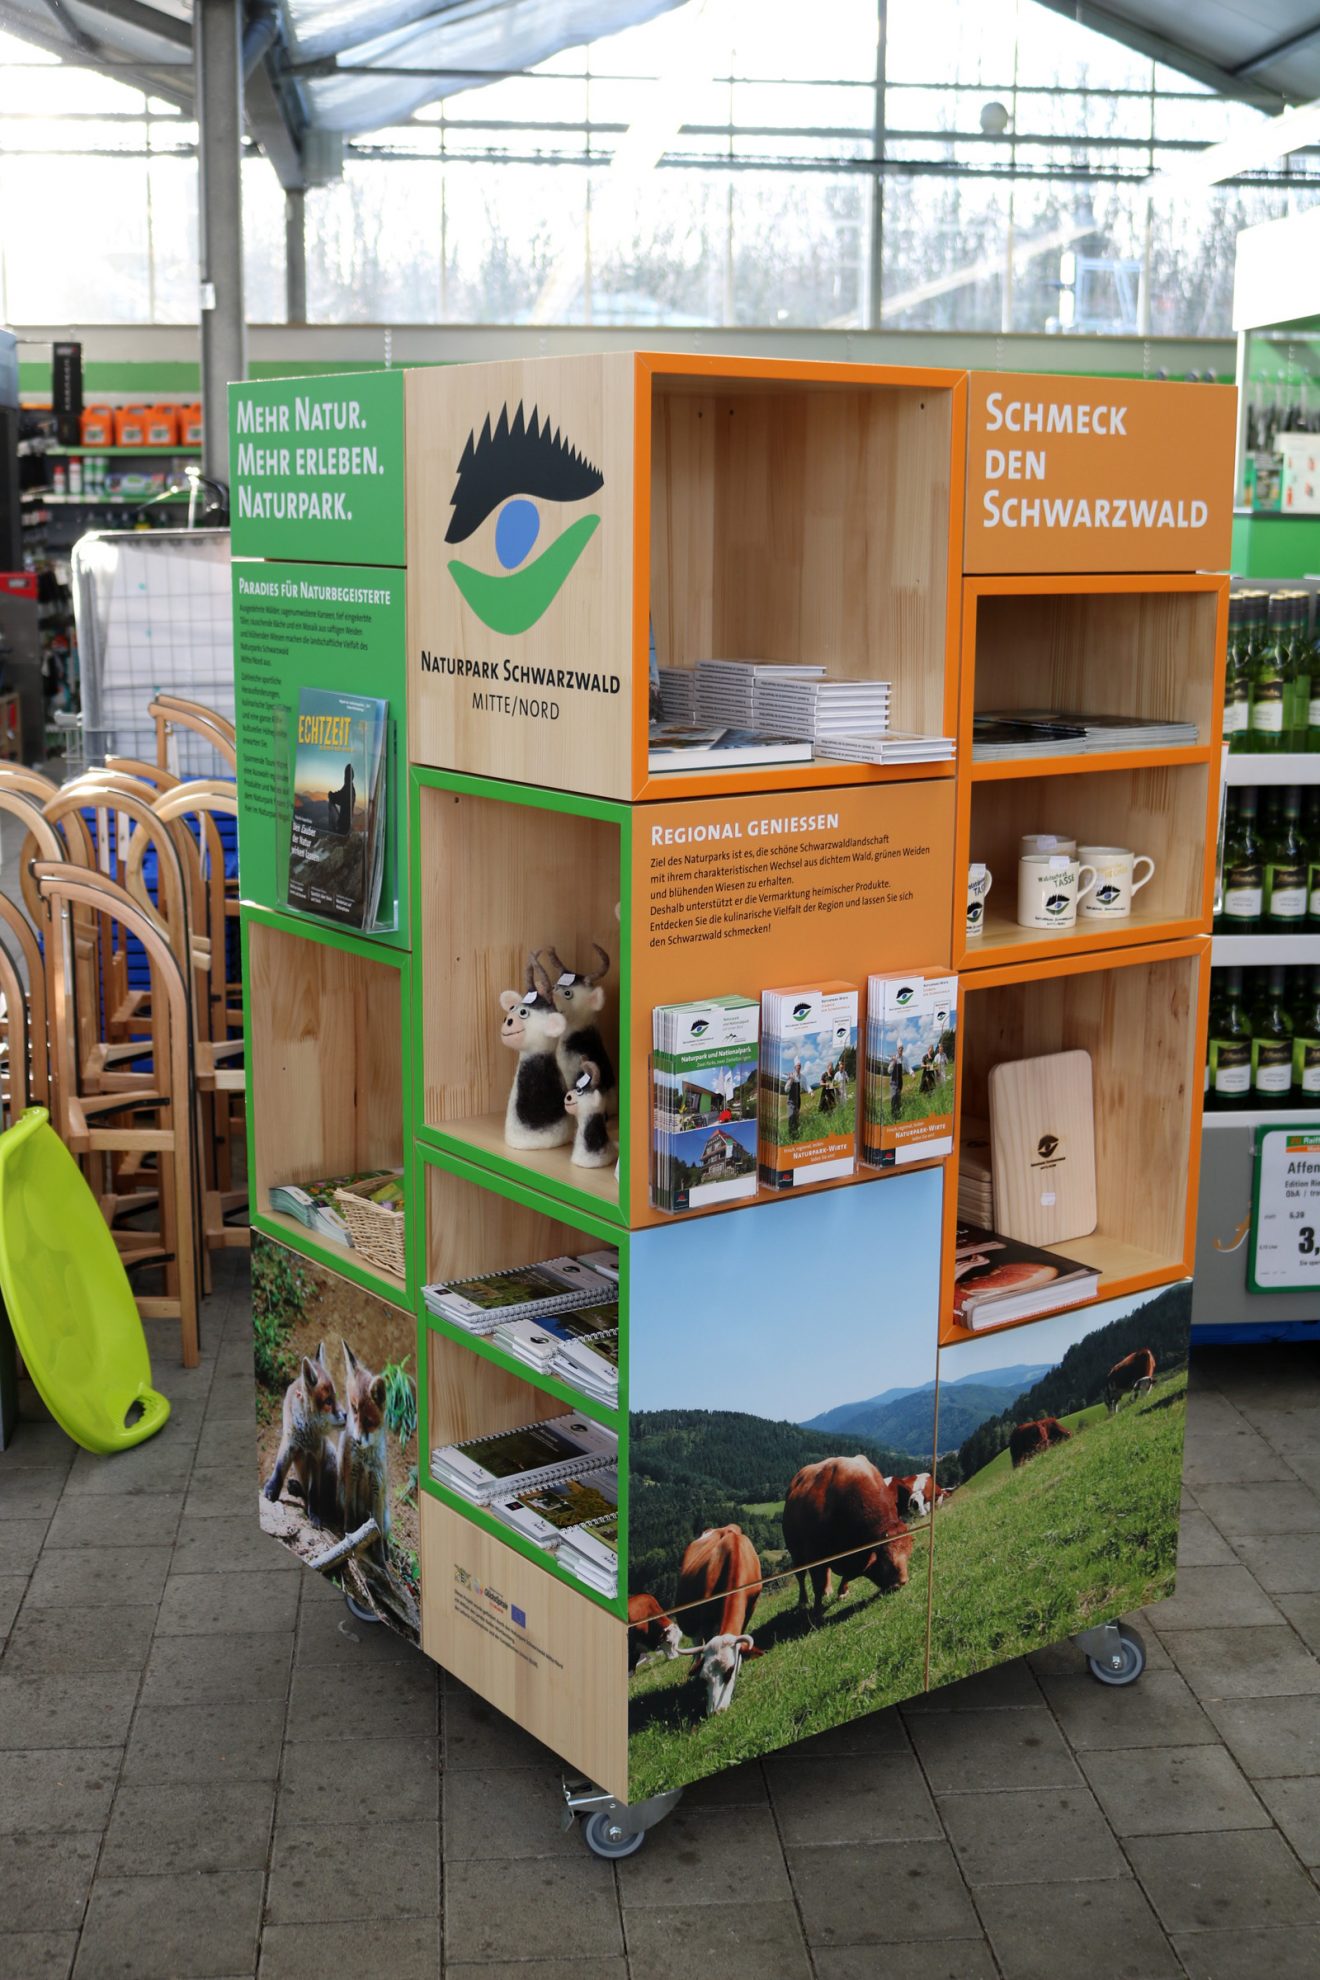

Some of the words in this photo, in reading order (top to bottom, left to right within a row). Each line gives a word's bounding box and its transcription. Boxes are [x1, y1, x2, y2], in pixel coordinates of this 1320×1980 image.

[237, 401, 290, 434] MEHR
[295, 397, 366, 430] NATUR.
[986, 392, 1127, 435] SCHMECK
[238, 442, 290, 476] MEHR
[296, 446, 384, 475] ERLEBEN.
[985, 449, 1046, 480] DEN
[238, 485, 352, 520] NATURPARK.
[983, 489, 1208, 528] SCHWARZWALD
[239, 577, 279, 597] PARADIES
[281, 580, 298, 598] FÜR
[300, 581, 391, 605] NATURBEGEISTERTE
[421, 650, 498, 680] NATURPARK
[503, 658, 621, 694] SCHWARZWALD
[472, 692, 560, 720] MITTE/NORD
[298, 715, 351, 746] ECHTZEIT
[651, 823, 742, 846] REGIONAL
[747, 813, 839, 836] GENIESSEN
[650, 873, 665, 884] mit
[667, 871, 692, 882] ihrem
[694, 863, 768, 880] charakteristischen
[770, 858, 802, 871] Wechsel
[804, 857, 818, 868] aus
[819, 853, 851, 866] dichtem
[852, 851, 874, 862] Wald,
[874, 848, 901, 862] grünen
[902, 846, 930, 857] Weiden
[651, 858, 666, 868] Ziel
[668, 856, 682, 866] des
[684, 850, 730, 865] Naturparks
[732, 849, 742, 860] ist
[744, 849, 755, 859] es,
[756, 847, 769, 857] die
[770, 844, 798, 856] schöne
[800, 834, 889, 853] Schwarzwaldlandschaft
[650, 889, 667, 900] und
[669, 884, 714, 898] blühenden
[715, 881, 745, 893] Wiesen
[747, 881, 757, 889] zu
[758, 875, 794, 888] erhalten.
[650, 903, 684, 916] Deshalb
[686, 898, 733, 912] unterstützt
[734, 897, 743, 906] er
[744, 894, 757, 905] die
[758, 888, 811, 903] Vermarktung
[812, 884, 854, 898] heimischer
[855, 880, 891, 892] Produkte.
[650, 918, 693, 932] Entdecken
[695, 916, 708, 926] Sie
[709, 914, 722, 924] die
[723, 908, 772, 923] kulinarische
[773, 903, 801, 916] Vielfalt
[803, 903, 816, 913] der
[818, 899, 844, 913] Region
[845, 898, 860, 908] und
[861, 894, 885, 905] lassen
[887, 893, 898, 903] Sie
[900, 891, 914, 902] sich
[650, 936, 666, 948] den
[667, 929, 722, 946] Schwarzwald
[724, 923, 771, 938] schmecken!
[681, 1053, 707, 1063] Naturpark
[708, 1051, 718, 1059] und
[719, 1046, 752, 1057] Nationalpark
